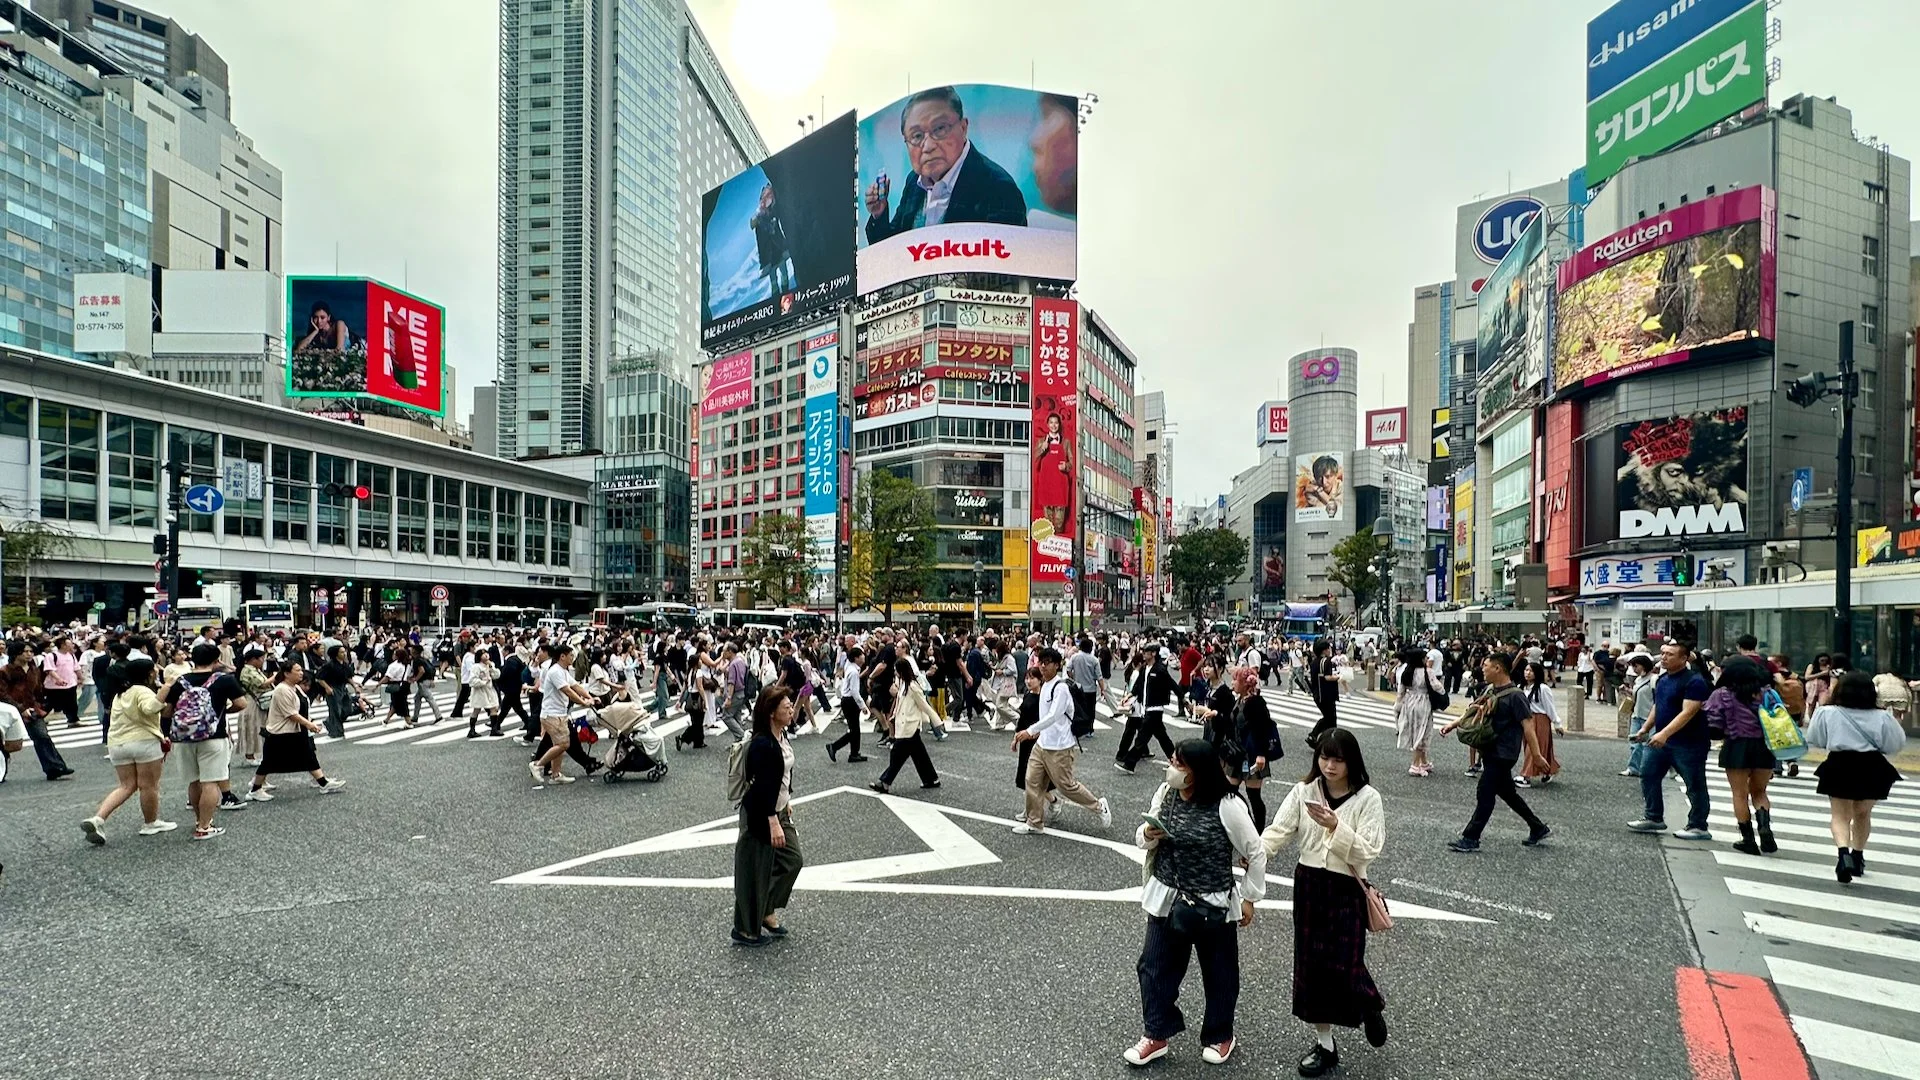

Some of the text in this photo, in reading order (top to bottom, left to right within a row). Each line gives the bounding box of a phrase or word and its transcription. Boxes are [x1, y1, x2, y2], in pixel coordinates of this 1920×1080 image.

[1595, 40, 1751, 156] サロンパス
[907, 238, 1011, 262] Yakult
[1593, 219, 1673, 262] Rakuten
[79, 295, 121, 306] 広告募集
[950, 289, 1028, 304] しゃぶしゃぶバイキング
[76, 322, 124, 331] 03-5774-7505
[857, 332, 868, 344] 9F
[1039, 309, 1055, 386] 推しから。
[939, 343, 1010, 361] コンタクト
[1055, 311, 1071, 386] 買うなら、
[900, 370, 926, 388] ガスト
[989, 370, 1022, 385] ガスト
[857, 403, 869, 415] 7F
[884, 391, 918, 414] ガスト
[808, 412, 822, 497] アイシティ
[822, 408, 833, 496] コンタクトの
[601, 478, 660, 489] MARK CITY
[1619, 502, 1745, 539] DMM
